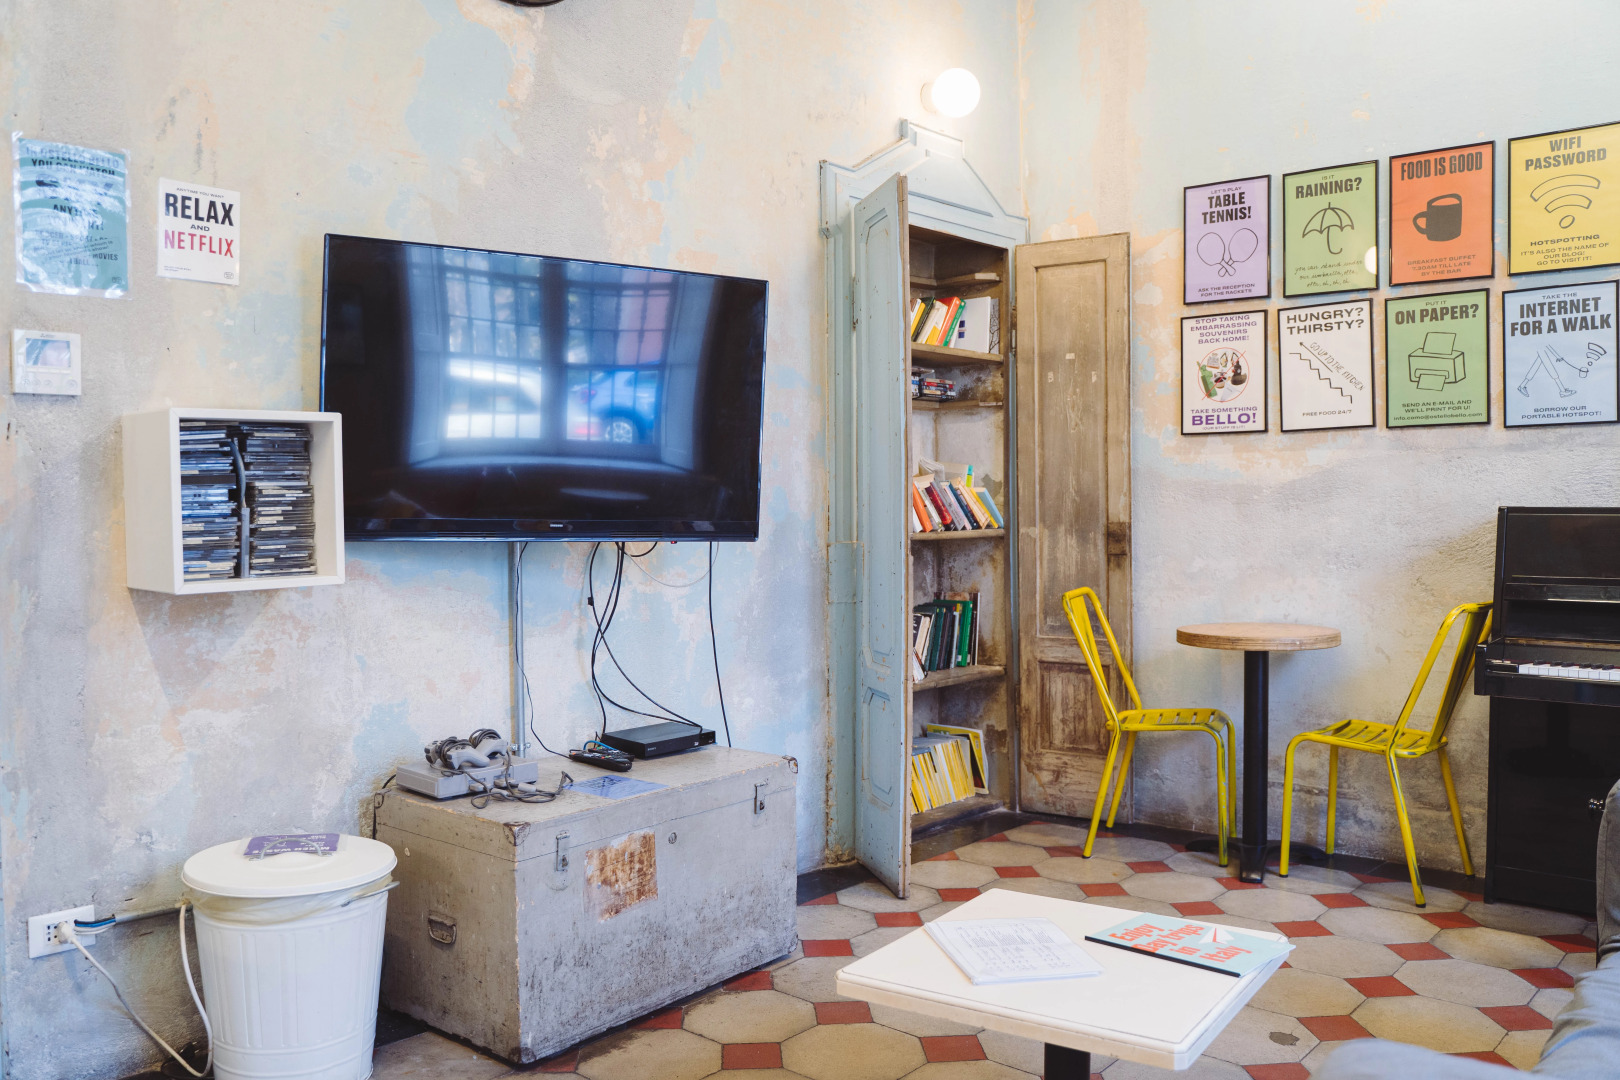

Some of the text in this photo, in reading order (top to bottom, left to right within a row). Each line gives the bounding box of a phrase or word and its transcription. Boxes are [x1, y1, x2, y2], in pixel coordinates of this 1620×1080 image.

[1549, 136, 1581, 152] WIFI
[1401, 151, 1483, 181] FOOD IS GOOD
[1525, 148, 1607, 171] PASSWORD
[1296, 177, 1362, 199] RAINING?
[1208, 192, 1246, 209] TABLE
[165, 192, 234, 227] RELAX
[1202, 206, 1252, 225] TENNIS!
[190, 224, 210, 232] AND
[164, 229, 234, 258] NETFLIX
[1530, 234, 1600, 246] HOTSPOTTING
[93, 253, 118, 261] MOVIES
[1408, 258, 1447, 266] BREAKFAST
[1286, 307, 1364, 324] HUNGRY?
[1395, 304, 1479, 325] ON PAPER?
[1520, 297, 1602, 319] INTERNET
[1191, 321, 1257, 332] EMBARRASSING
[1200, 329, 1248, 337] SOUVENIRS
[1287, 319, 1364, 335] THIRSTY?
[1511, 314, 1612, 337] FOR A WALK
[1310, 342, 1320, 351] GO
[1318, 348, 1328, 356] UP
[1324, 355, 1335, 364] TO
[1332, 361, 1344, 373] THE
[1192, 412, 1256, 426] BELLO!
[1108, 923, 1165, 942] Enjoy
[1161, 924, 1205, 941] trips
[1170, 945, 1200, 956] in
[1198, 945, 1253, 963] Italy
